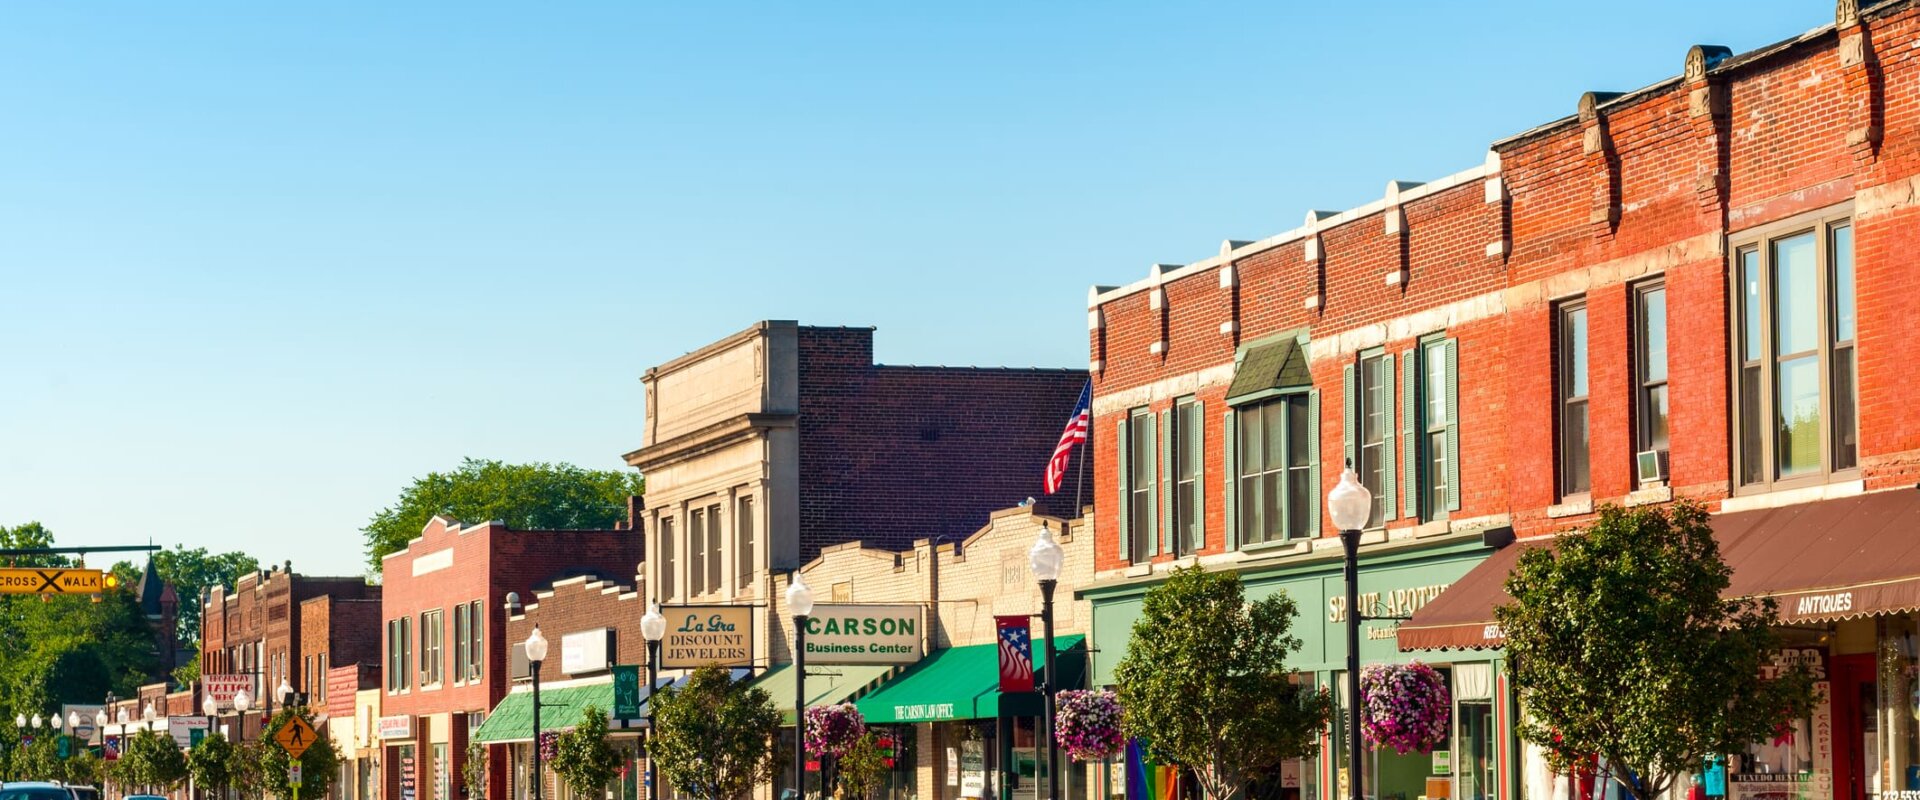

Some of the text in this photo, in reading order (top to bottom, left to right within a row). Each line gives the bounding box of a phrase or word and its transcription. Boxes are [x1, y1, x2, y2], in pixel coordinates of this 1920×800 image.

[63, 576, 97, 587] WALK
[1329, 592, 1380, 623] SPIT
[1797, 592, 1852, 616] ANTIQUES
[677, 614, 735, 632] La Gra
[805, 617, 915, 636] CARSON
[1483, 625, 1499, 639] RED
[670, 634, 743, 646] DISCOUNT
[806, 642, 913, 653] Business Center
[667, 648, 746, 659] JEWELERS
[206, 683, 253, 692] TATTOO
[895, 703, 954, 720] THE CARSON LAW OFFICE
[1818, 713, 1830, 759] CARPET
[1738, 774, 1773, 782] TUXEDO
[1818, 768, 1831, 800] BOUT
